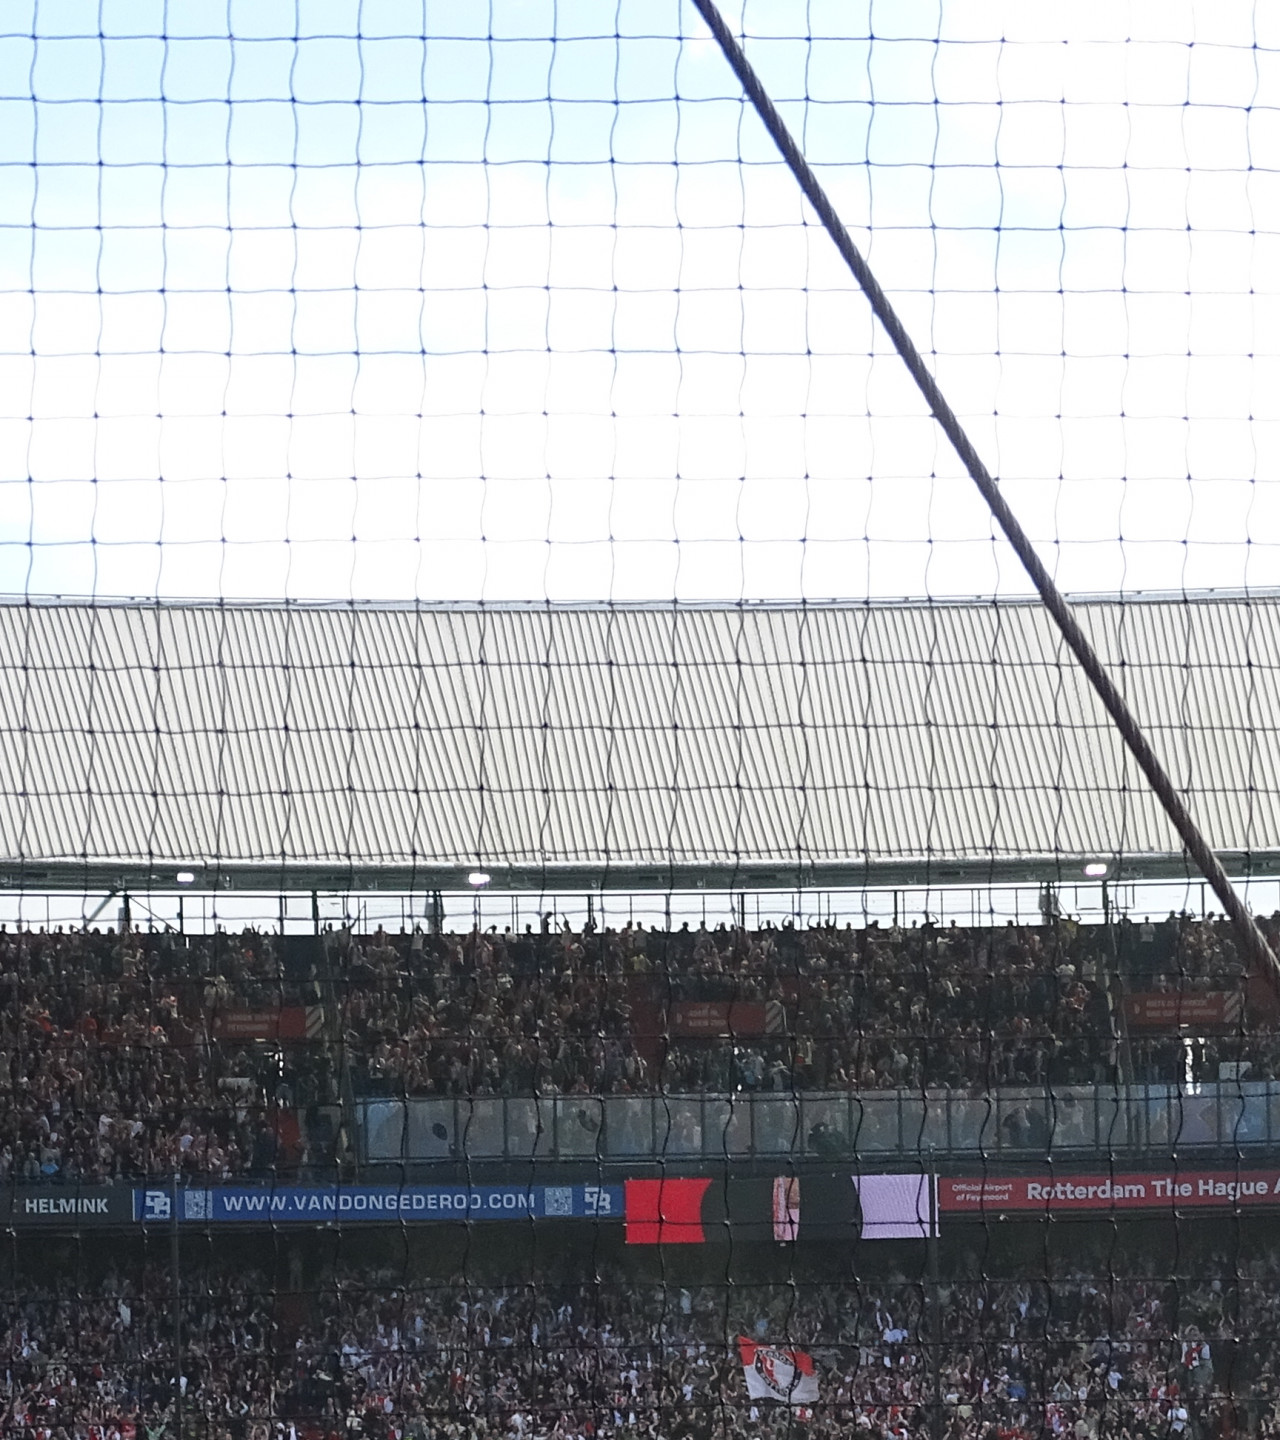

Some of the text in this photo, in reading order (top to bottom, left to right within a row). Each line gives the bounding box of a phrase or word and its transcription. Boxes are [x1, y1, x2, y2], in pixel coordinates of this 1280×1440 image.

[1027, 1180, 1145, 1202] Rotterdam
[1152, 1178, 1192, 1197] The
[1199, 1179, 1268, 1201] Hague
[25, 1197, 109, 1214] HELMINK
